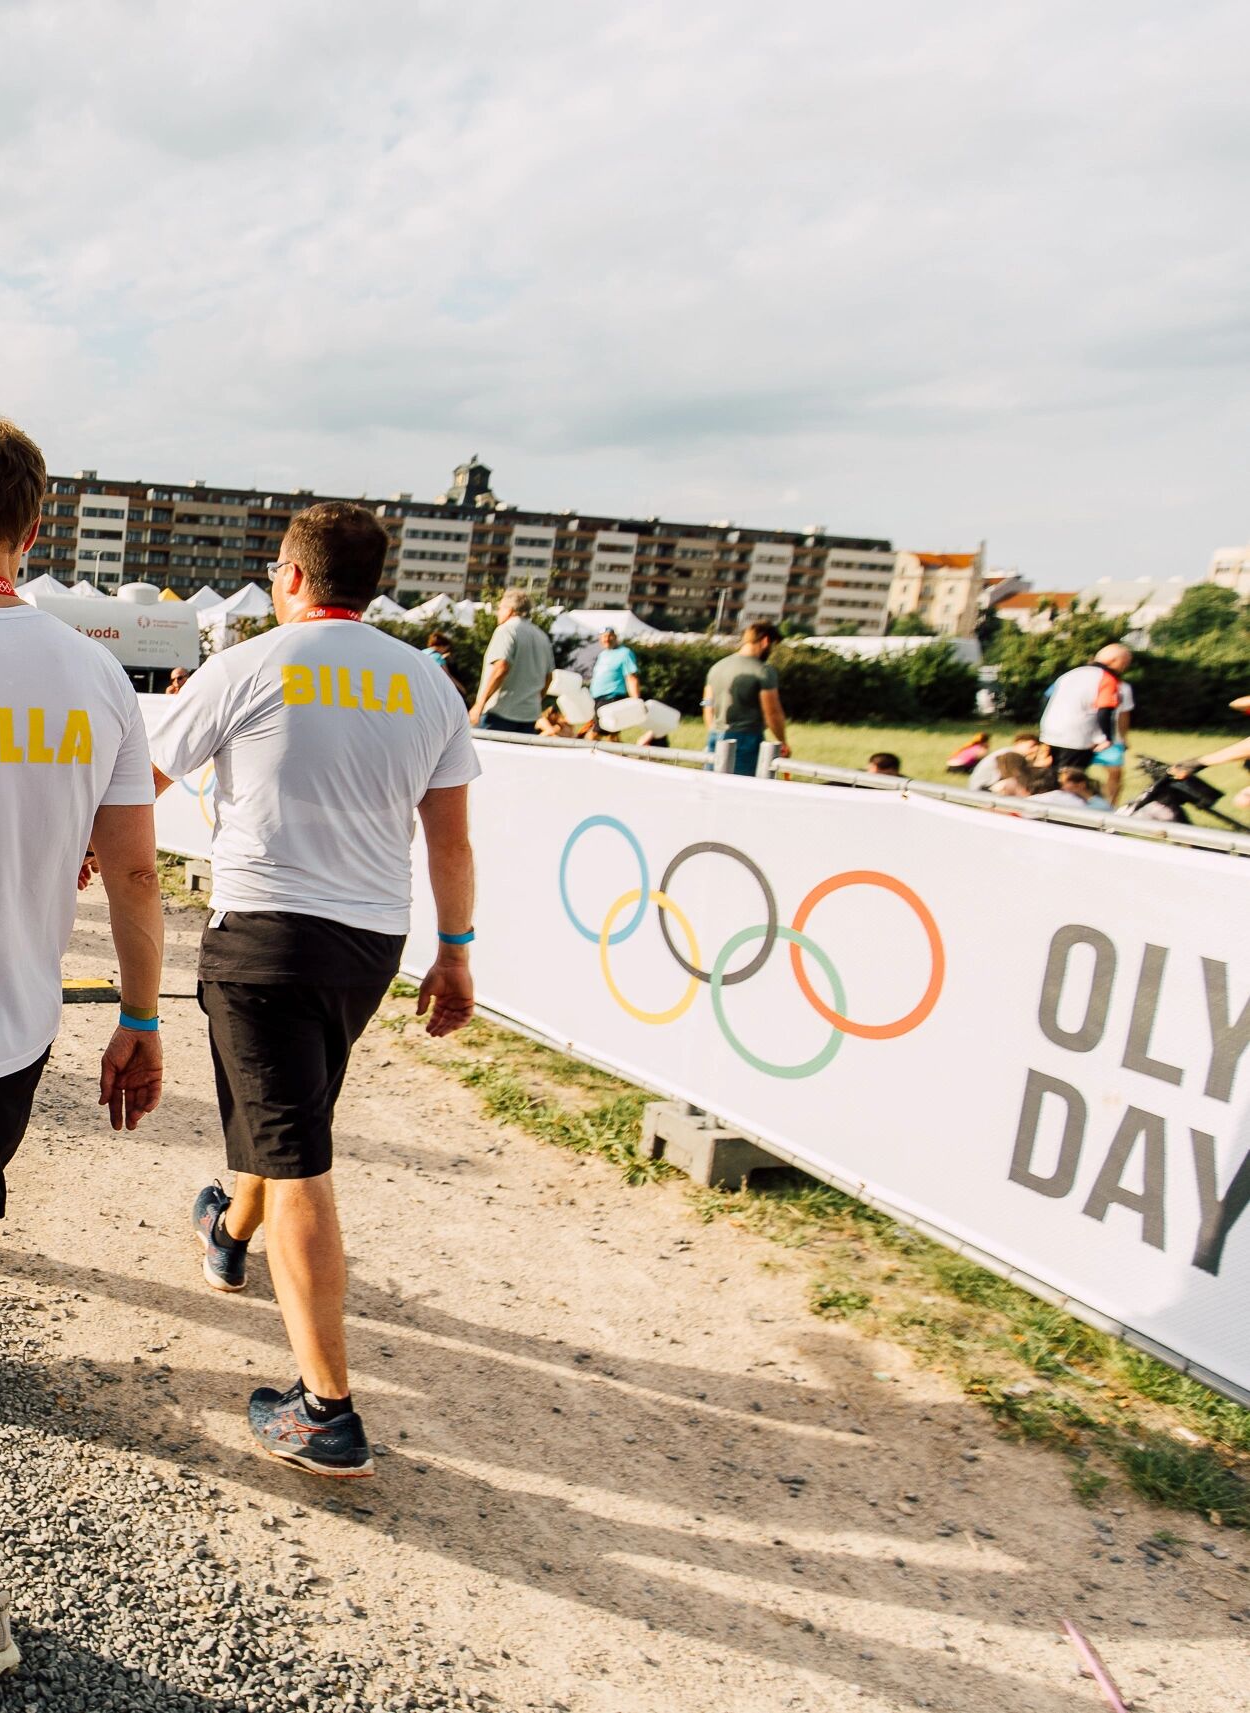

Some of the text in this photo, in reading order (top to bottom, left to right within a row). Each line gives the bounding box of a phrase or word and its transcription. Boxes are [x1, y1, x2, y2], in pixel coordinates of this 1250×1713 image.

[86, 627, 120, 639] voda
[281, 664, 415, 715] BILLA
[1008, 1067, 1250, 1277] DAY
